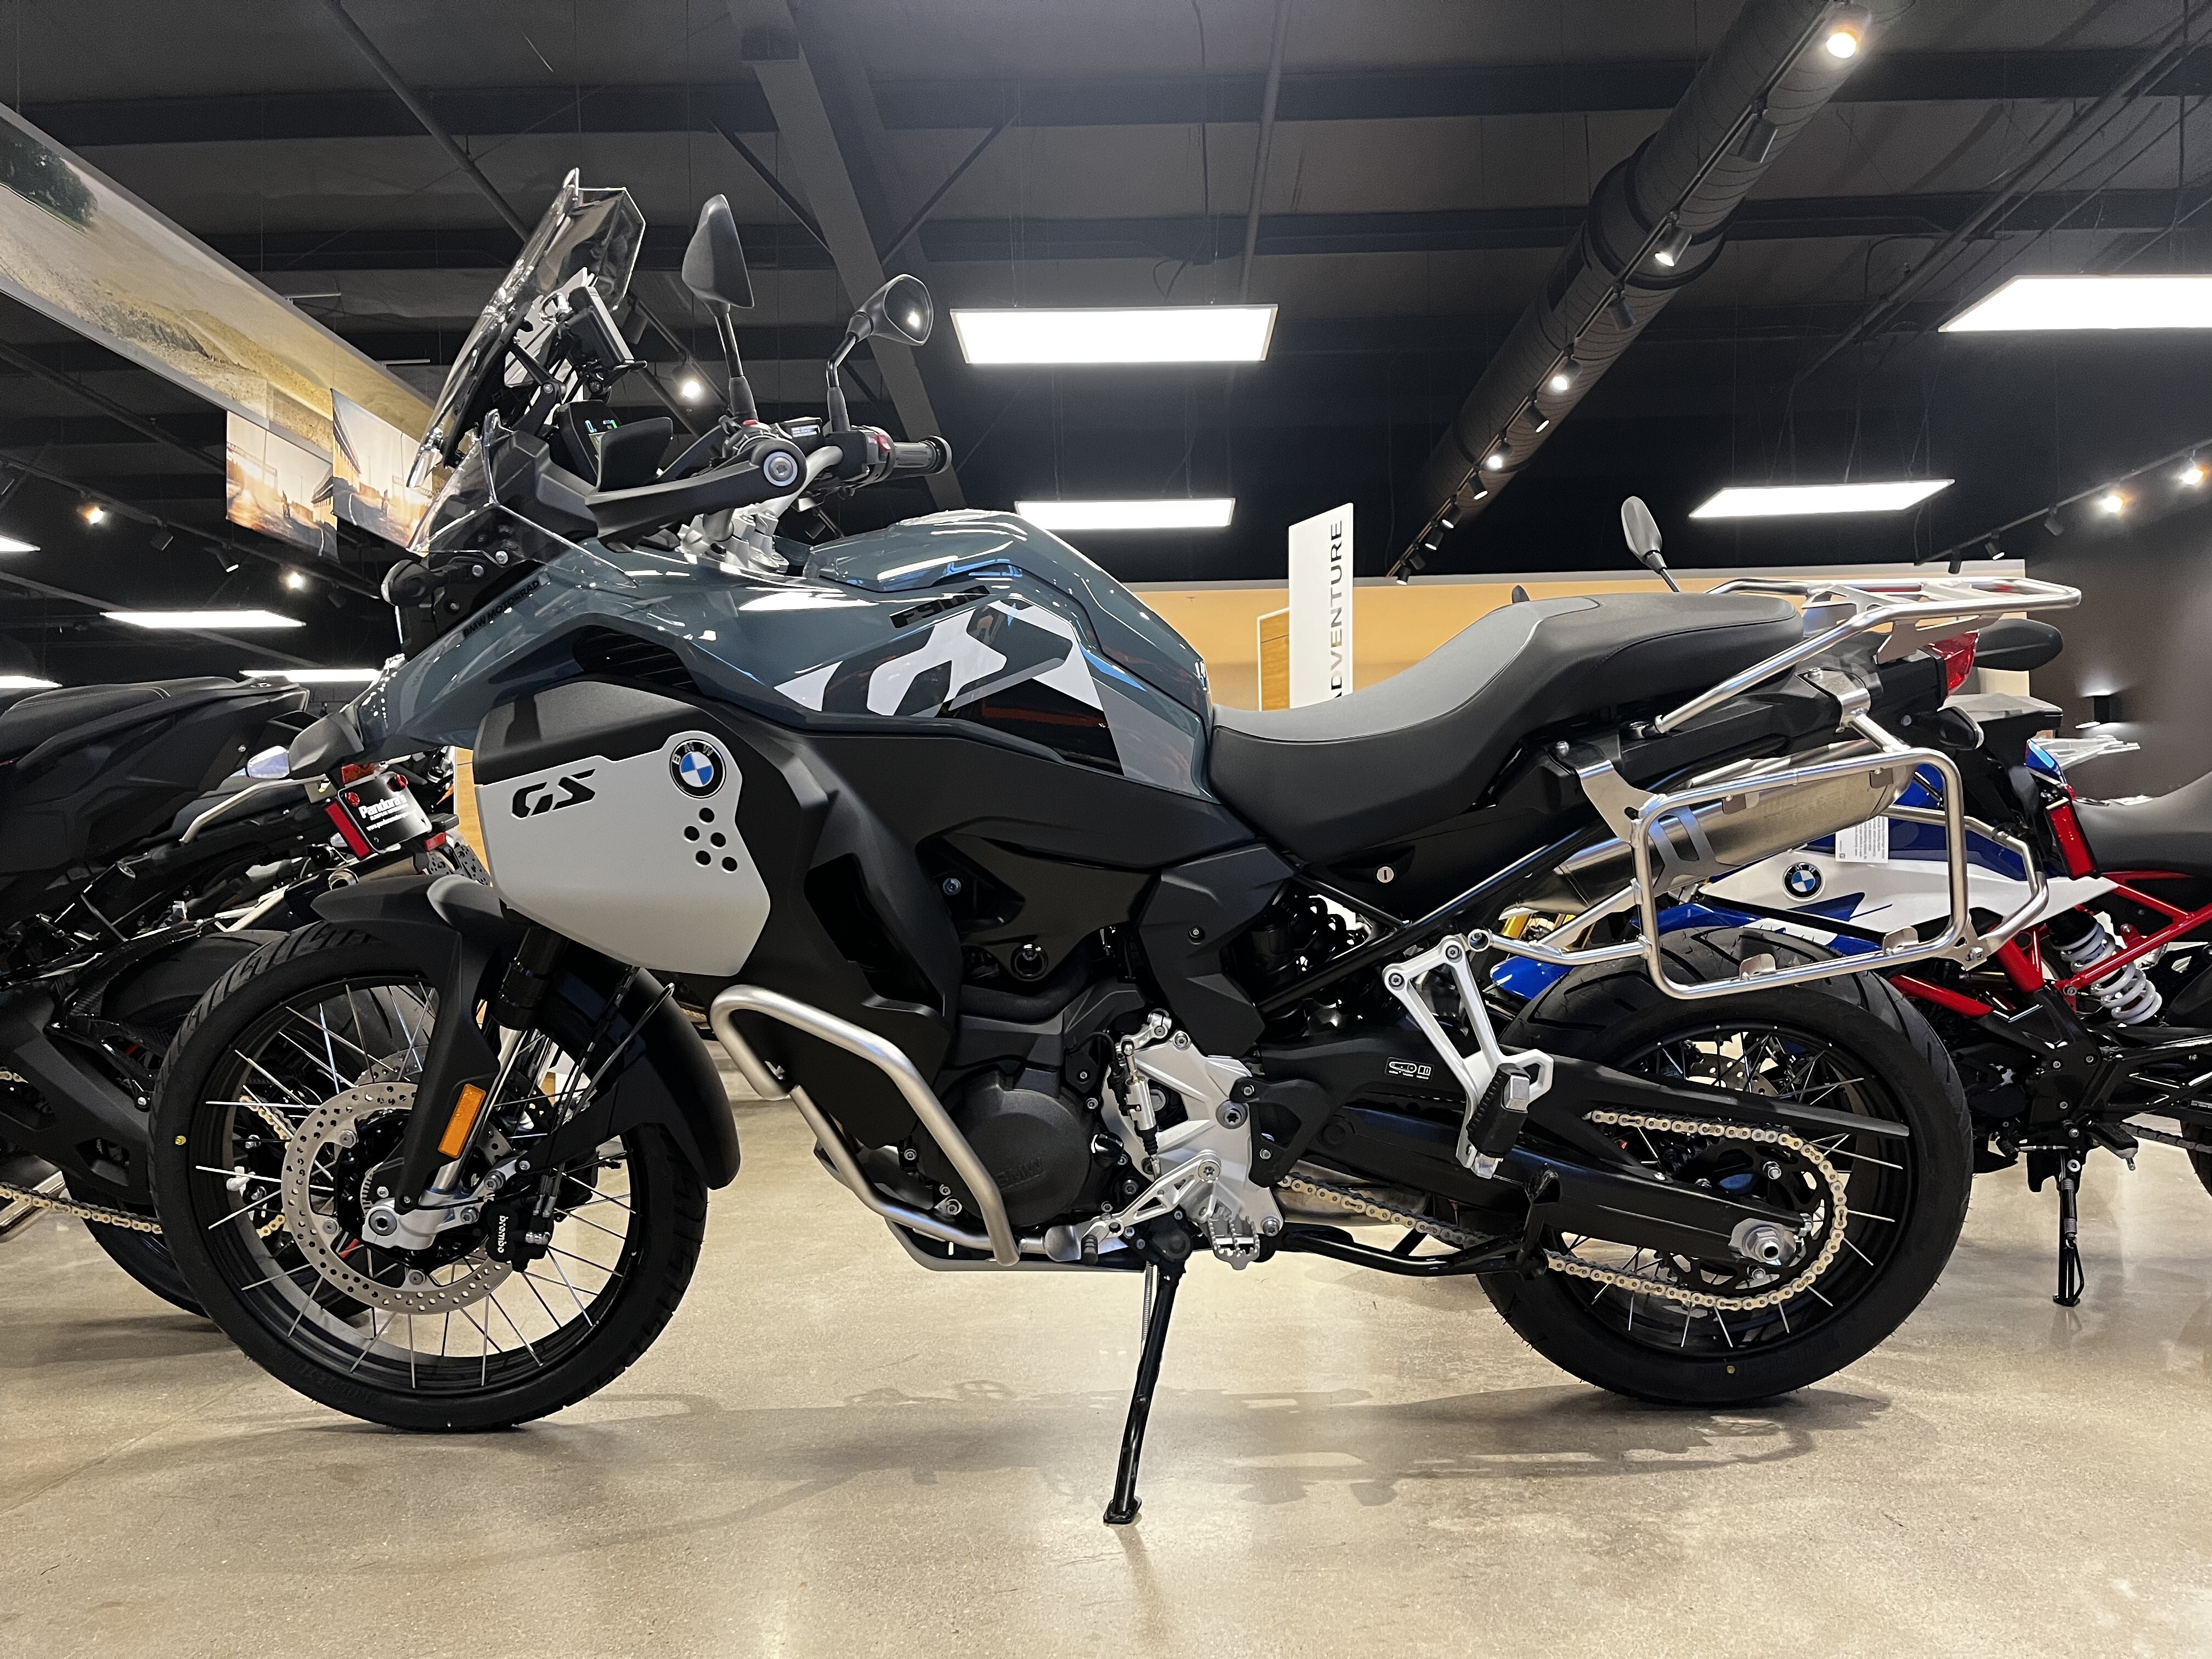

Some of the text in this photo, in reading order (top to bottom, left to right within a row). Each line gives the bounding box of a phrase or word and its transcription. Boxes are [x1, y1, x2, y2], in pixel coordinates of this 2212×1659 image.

[463, 615, 487, 638] BMW
[672, 741, 714, 765] BMW
[512, 769, 596, 819] GS
[358, 794, 407, 819] Pandora's
[1786, 865, 1816, 879] BMW
[497, 1215, 509, 1254] brembo
